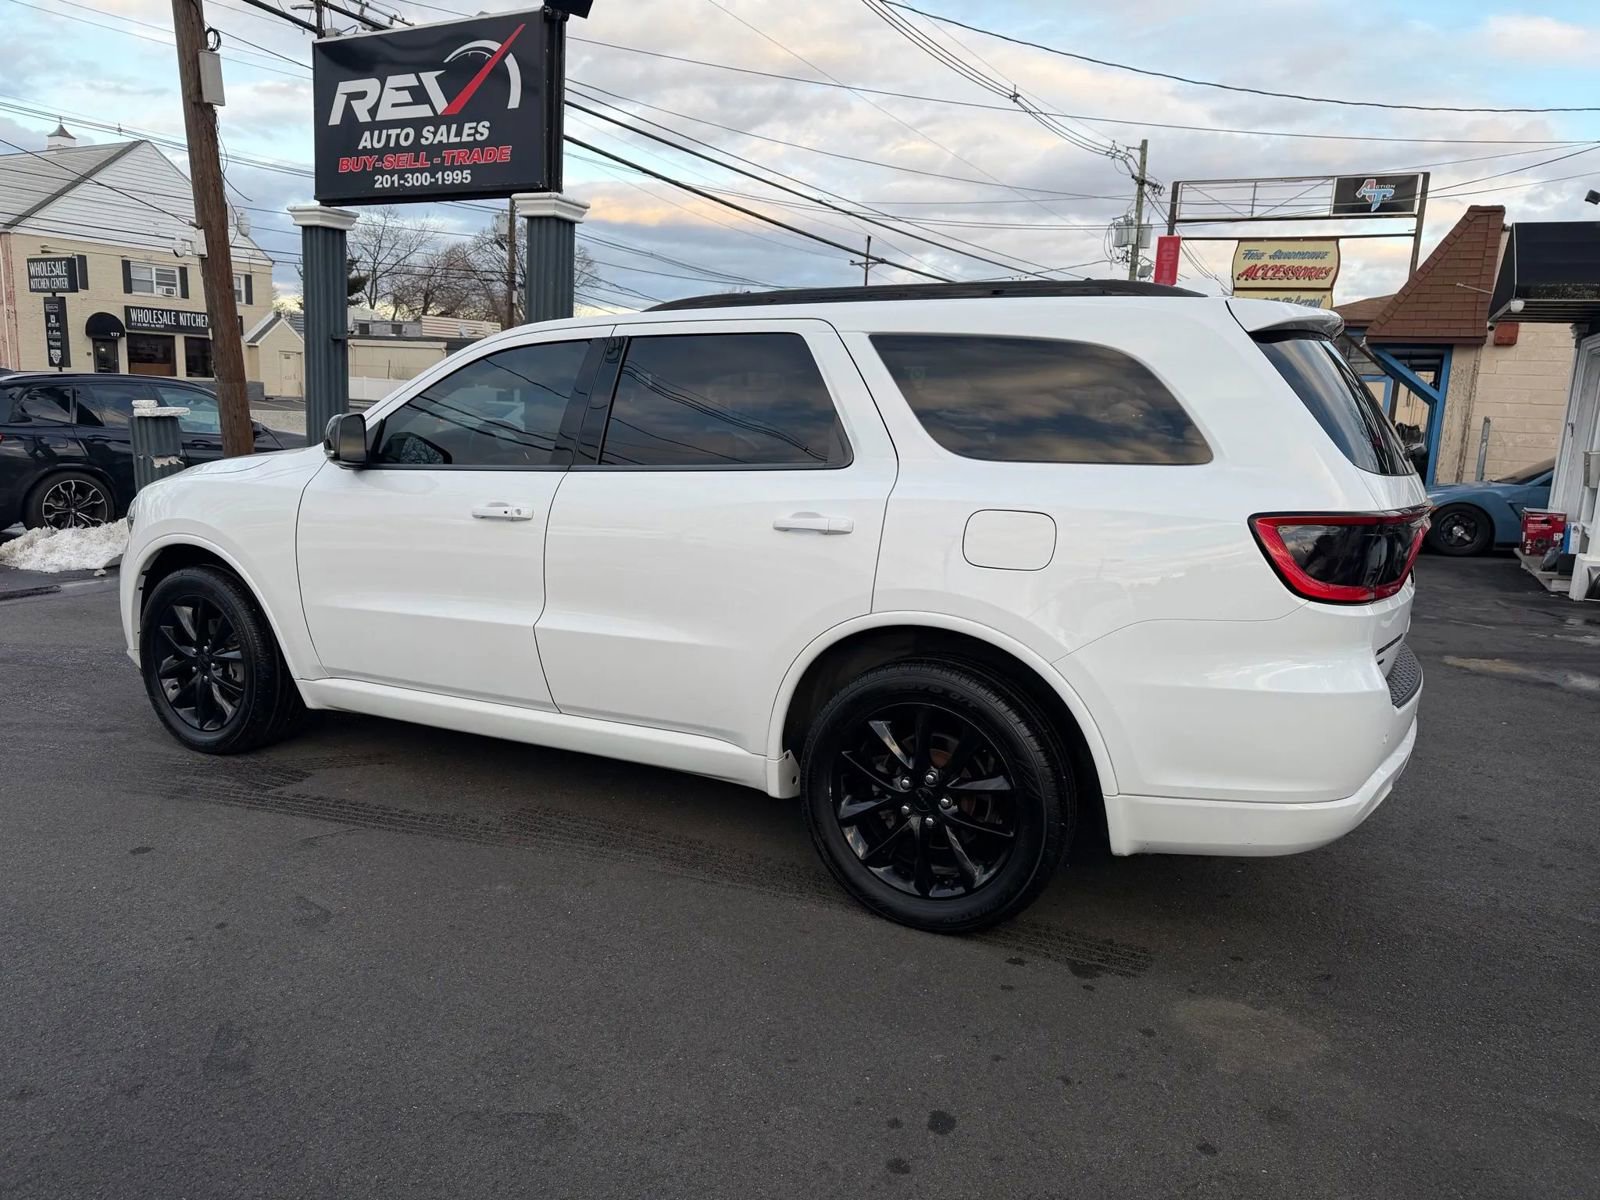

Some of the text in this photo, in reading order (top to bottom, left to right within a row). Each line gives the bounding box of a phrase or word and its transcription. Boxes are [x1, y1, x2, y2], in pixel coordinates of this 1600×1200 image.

[358, 120, 491, 150] AUTO SALES
[374, 169, 472, 189] 201-300-1995
[28, 261, 68, 276] WHOLESALE
[1236, 263, 1334, 281] ACCESSORIES
[30, 277, 69, 289] KITCHEN CENTER
[130, 308, 177, 326] WHOLESALE
